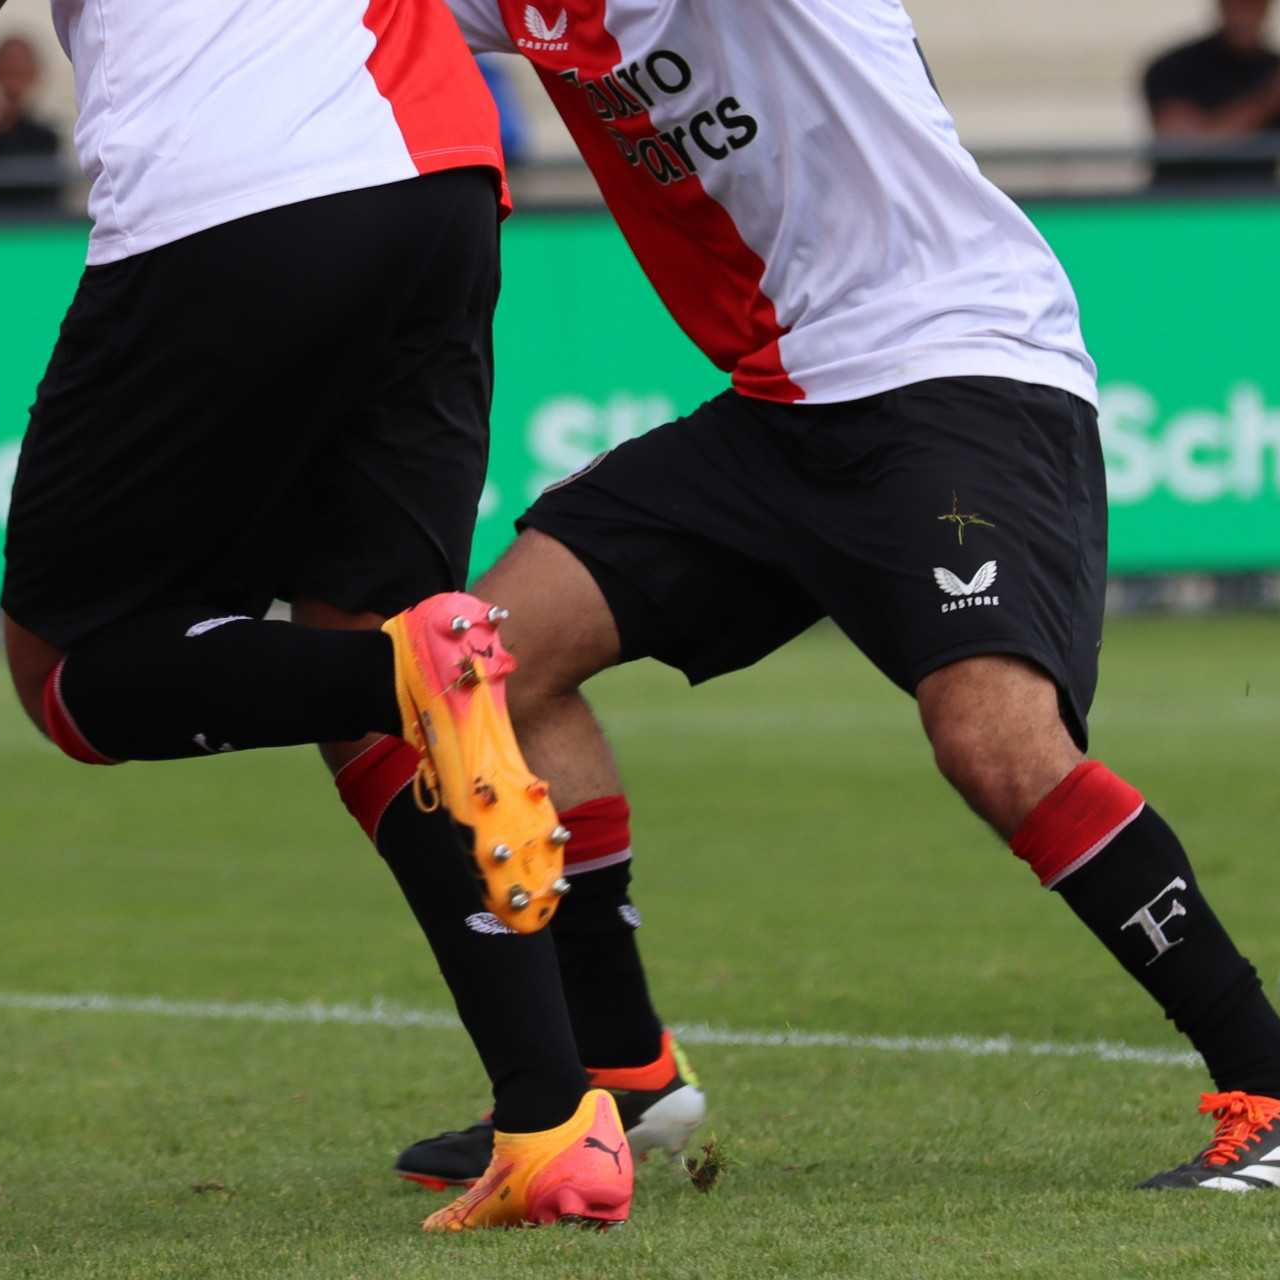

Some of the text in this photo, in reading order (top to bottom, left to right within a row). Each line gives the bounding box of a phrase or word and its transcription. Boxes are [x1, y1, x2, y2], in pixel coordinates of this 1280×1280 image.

[517, 38, 570, 51] CASTORE
[941, 596, 1000, 613] CASTORE
[1121, 876, 1187, 966] F
